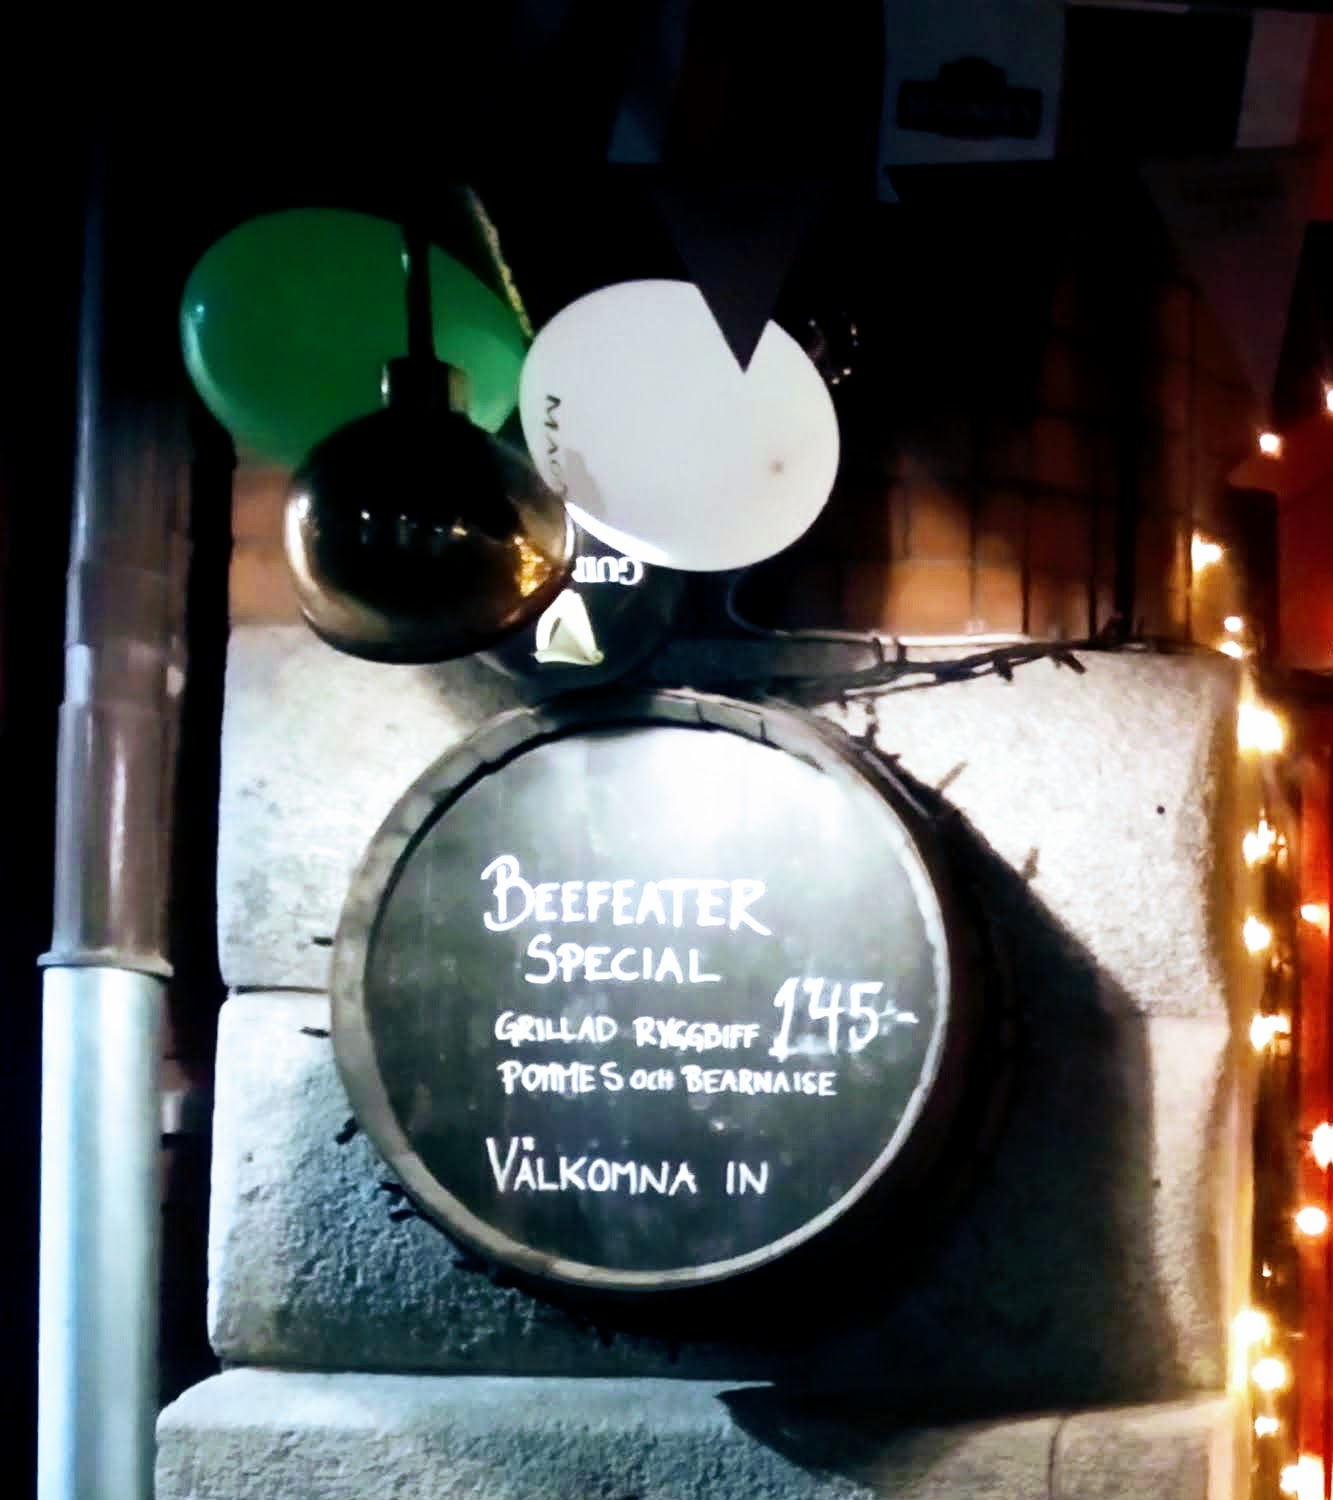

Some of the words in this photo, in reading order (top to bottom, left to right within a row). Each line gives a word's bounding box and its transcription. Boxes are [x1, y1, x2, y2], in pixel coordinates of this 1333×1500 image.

[480, 854, 772, 936] BEEFEATER
[524, 933, 722, 985] SPECIAL
[494, 1010, 618, 1048] GRILLAD
[632, 1015, 761, 1052] RYGGBIFF
[496, 1060, 624, 1096] POMMES
[680, 1064, 838, 1097] BEARNAISE
[485, 1136, 699, 1196] VÄLKOMNA
[725, 1160, 770, 1195] IN
